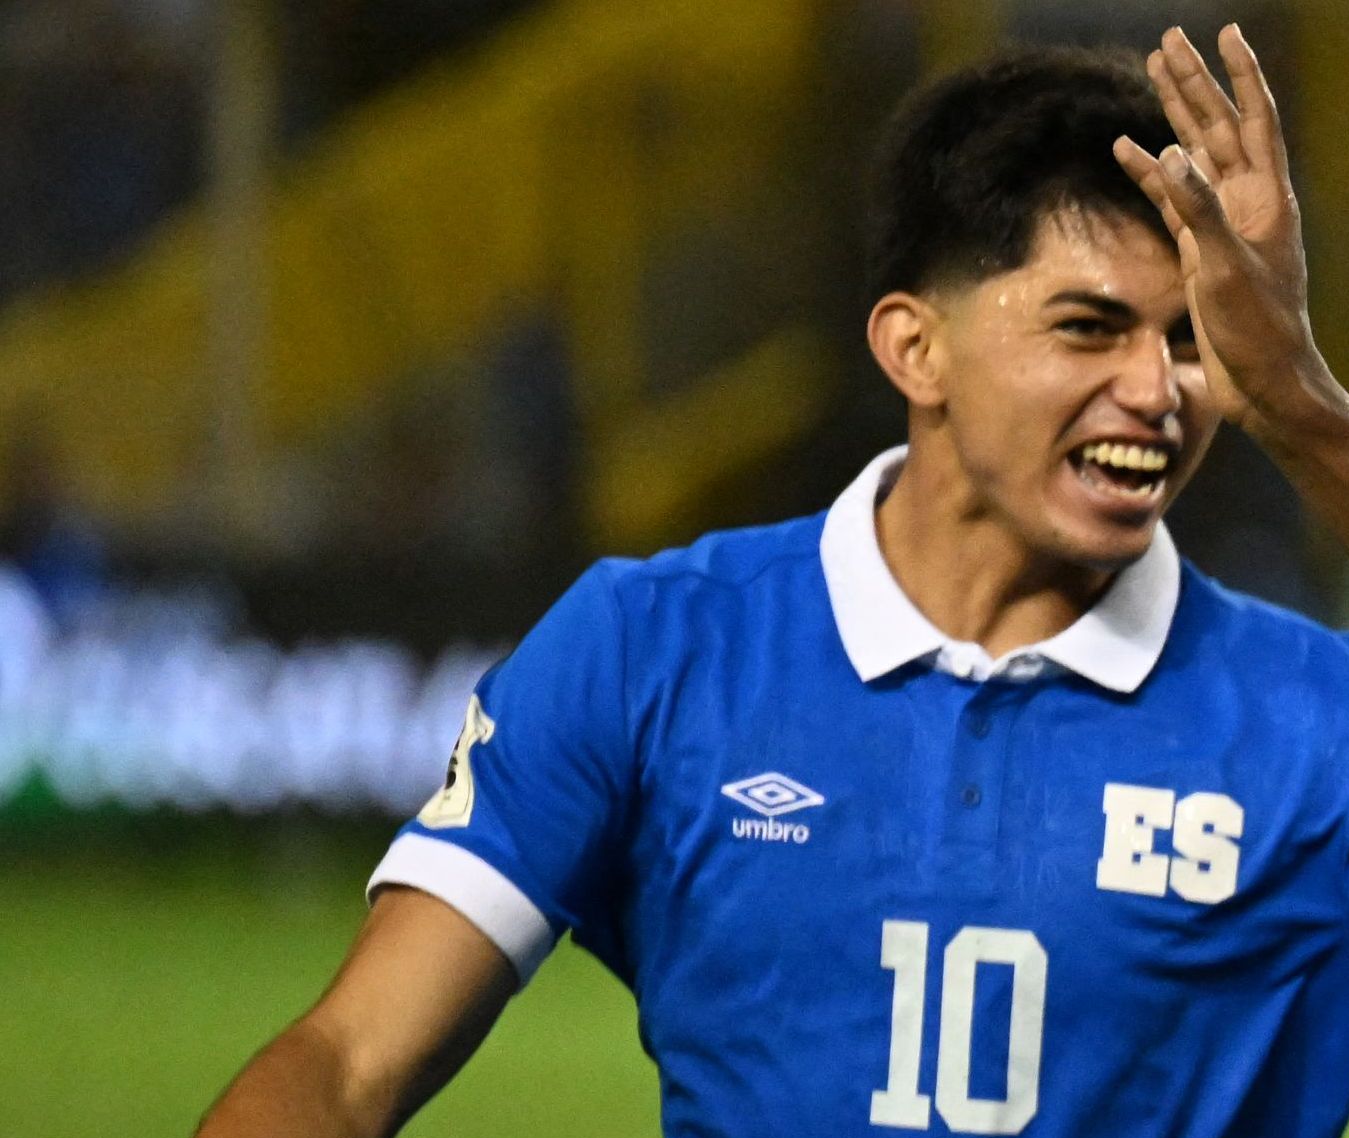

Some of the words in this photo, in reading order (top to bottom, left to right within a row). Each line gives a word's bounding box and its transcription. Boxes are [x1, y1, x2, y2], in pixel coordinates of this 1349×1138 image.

[733, 815, 809, 844] umbro
[1096, 783, 1244, 904] ES
[870, 920, 1048, 1134] 10
